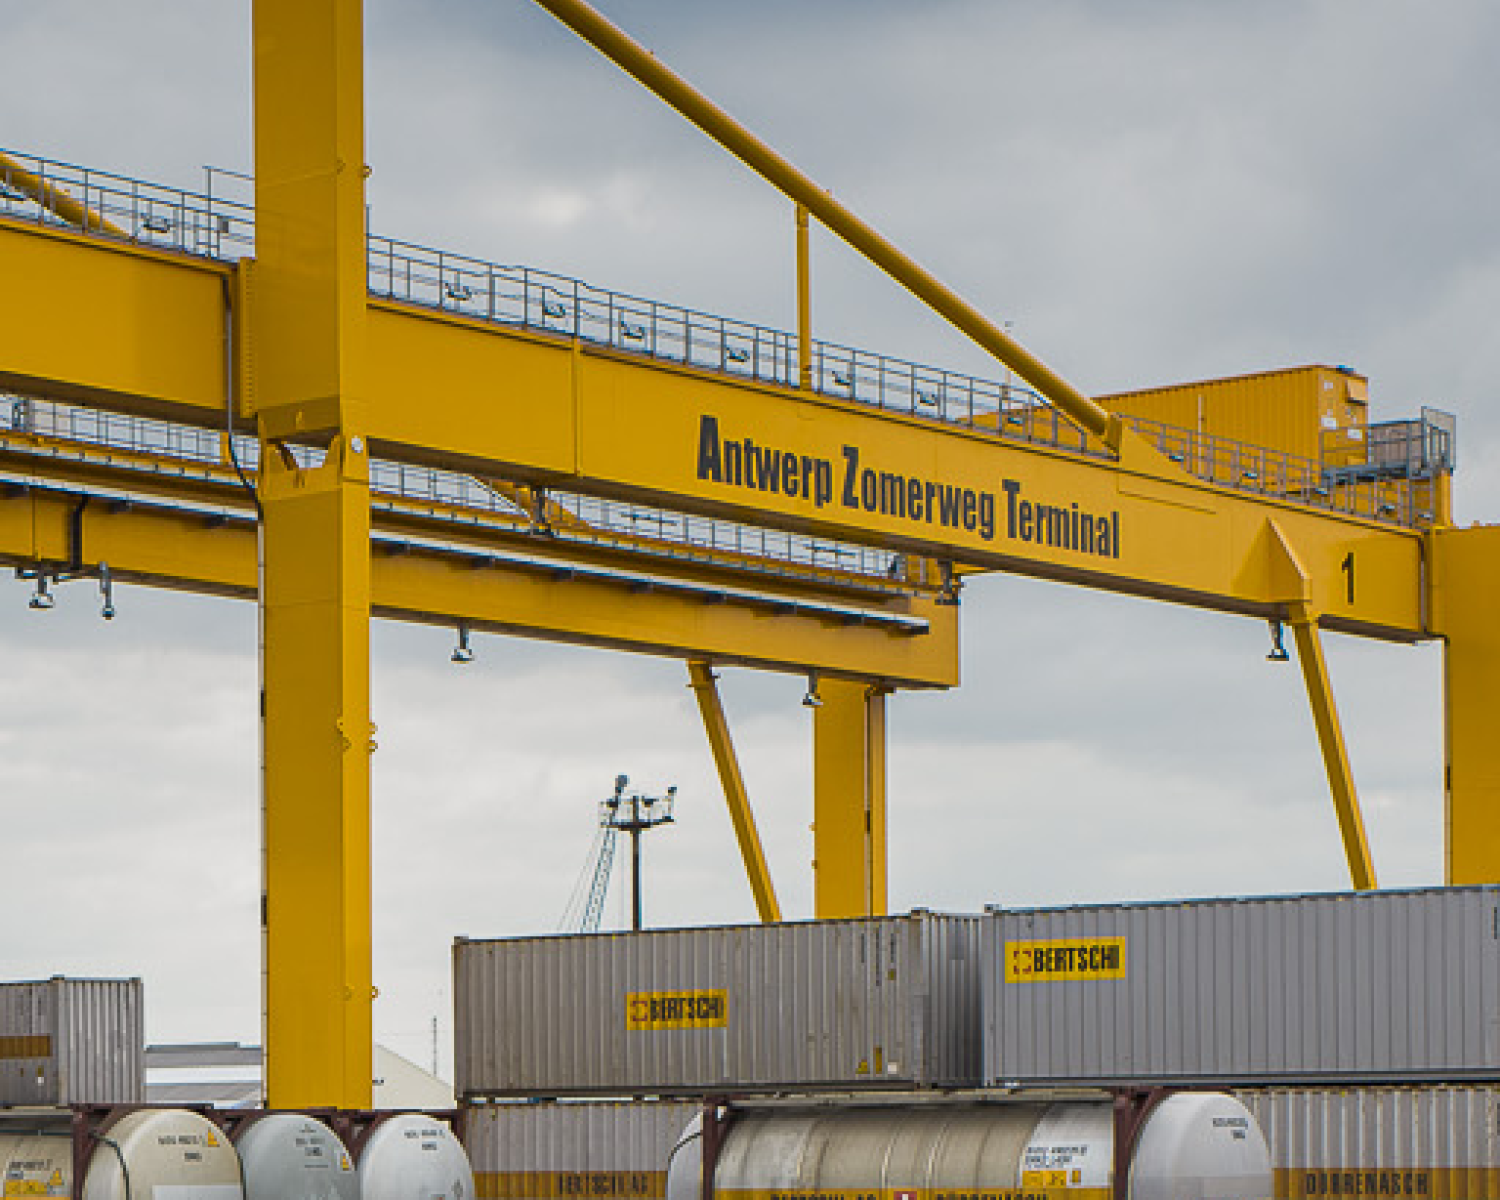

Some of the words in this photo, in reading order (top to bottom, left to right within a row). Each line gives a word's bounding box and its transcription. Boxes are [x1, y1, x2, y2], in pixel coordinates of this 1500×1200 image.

[697, 414, 831, 506] Antwerp
[842, 445, 996, 540] Zomerweg
[1003, 478, 1120, 559] Terminal
[1341, 552, 1355, 604] 1
[1033, 944, 1120, 973] BERTSCHI
[649, 995, 725, 1022] BERTSCHI
